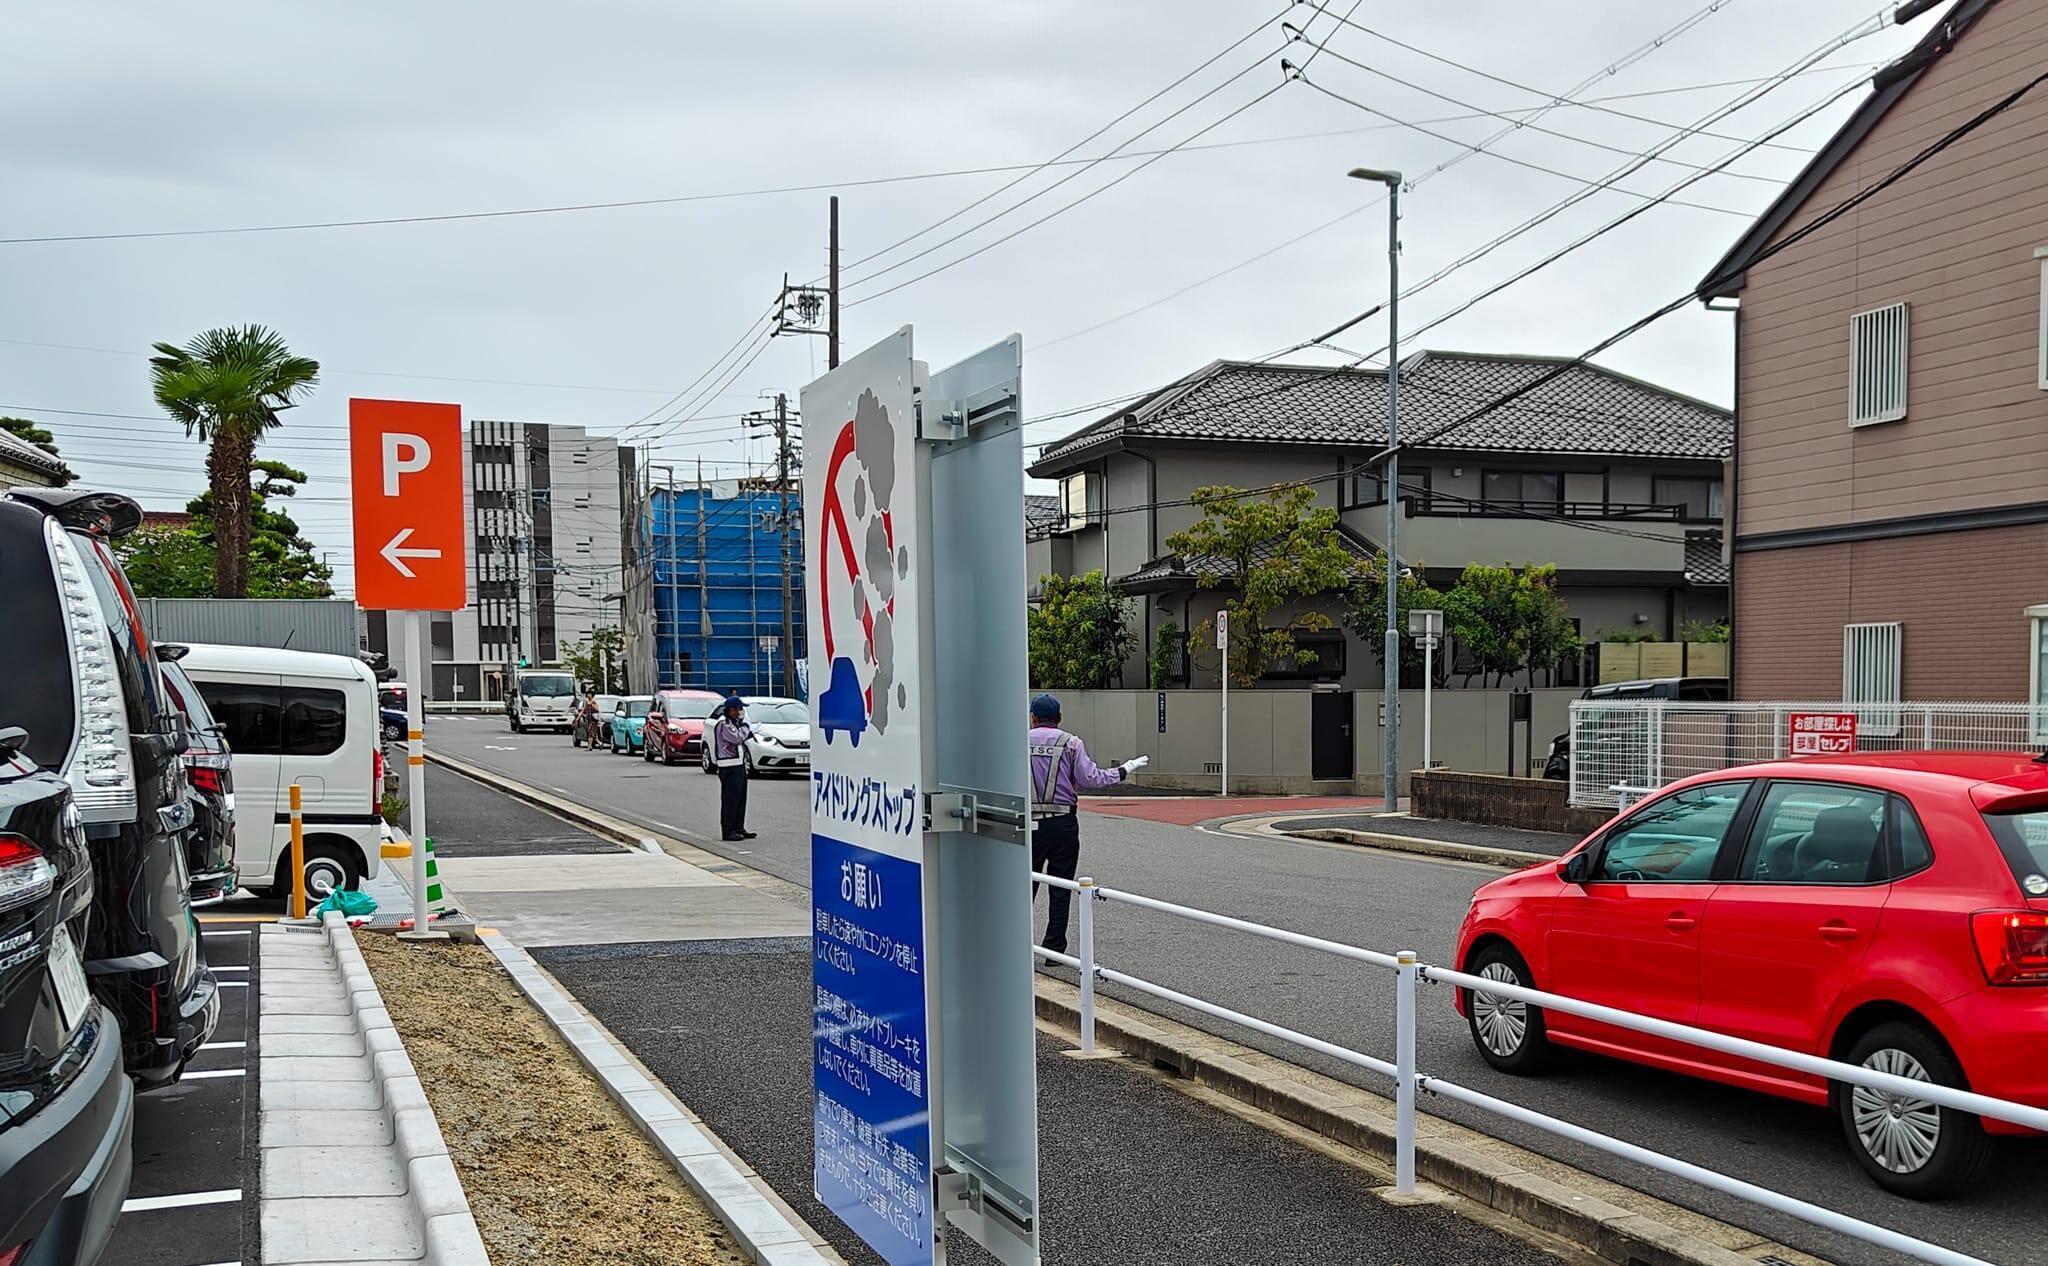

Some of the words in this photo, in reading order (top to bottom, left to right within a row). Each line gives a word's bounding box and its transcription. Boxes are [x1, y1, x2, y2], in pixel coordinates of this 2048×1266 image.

[382, 432, 432, 497] P
[813, 771, 916, 836] アイドリングストップ
[841, 859, 882, 909] お願い
[816, 908, 919, 973] 駐車したら速やかにエンジンを停止
[817, 937, 856, 976] してください。
[818, 1046, 871, 1096] しないでください。
